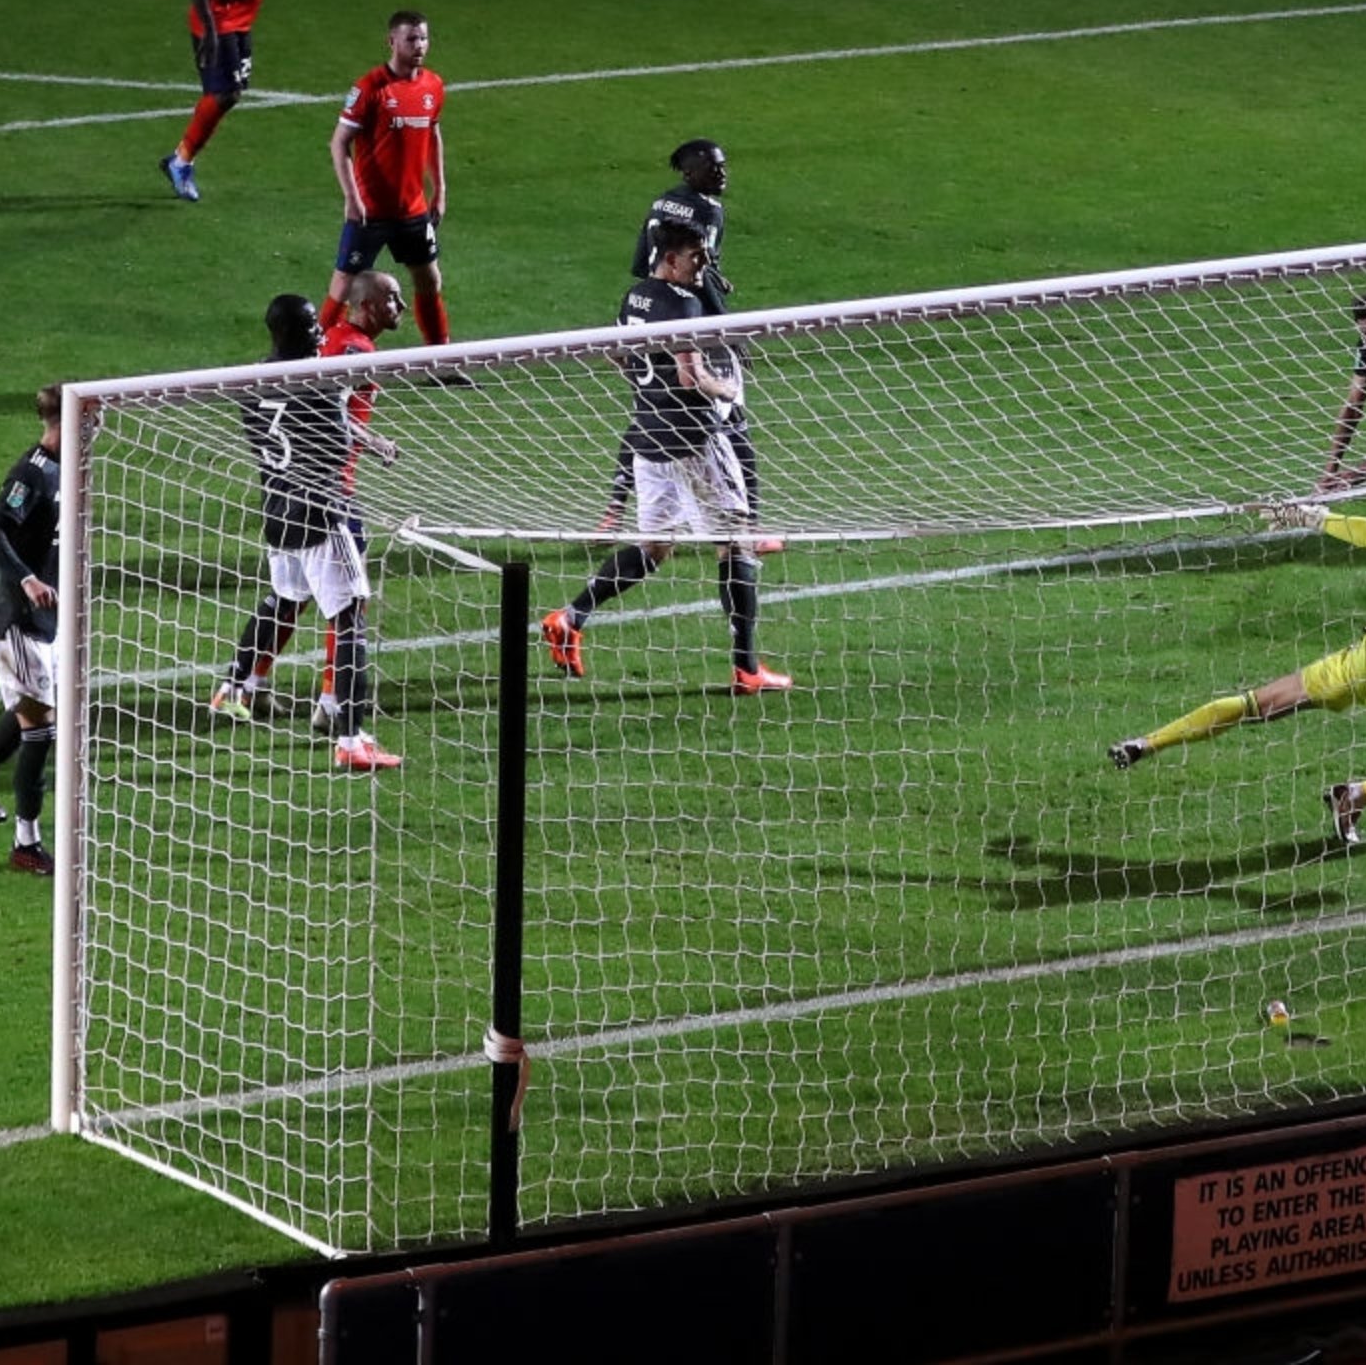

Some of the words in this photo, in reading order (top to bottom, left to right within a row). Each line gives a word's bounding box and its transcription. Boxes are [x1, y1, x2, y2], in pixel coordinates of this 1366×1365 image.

[258, 399, 292, 470] 3
[1198, 1180, 1218, 1204] IT
[1226, 1176, 1244, 1200] IS
[1253, 1169, 1286, 1195] AN
[1217, 1205, 1245, 1230] TO
[1252, 1192, 1319, 1223] ENTER
[1327, 1183, 1366, 1210] THE
[1210, 1224, 1300, 1260] PLAYING
[1308, 1213, 1366, 1242] AREA
[1177, 1259, 1257, 1292] UNLESS
